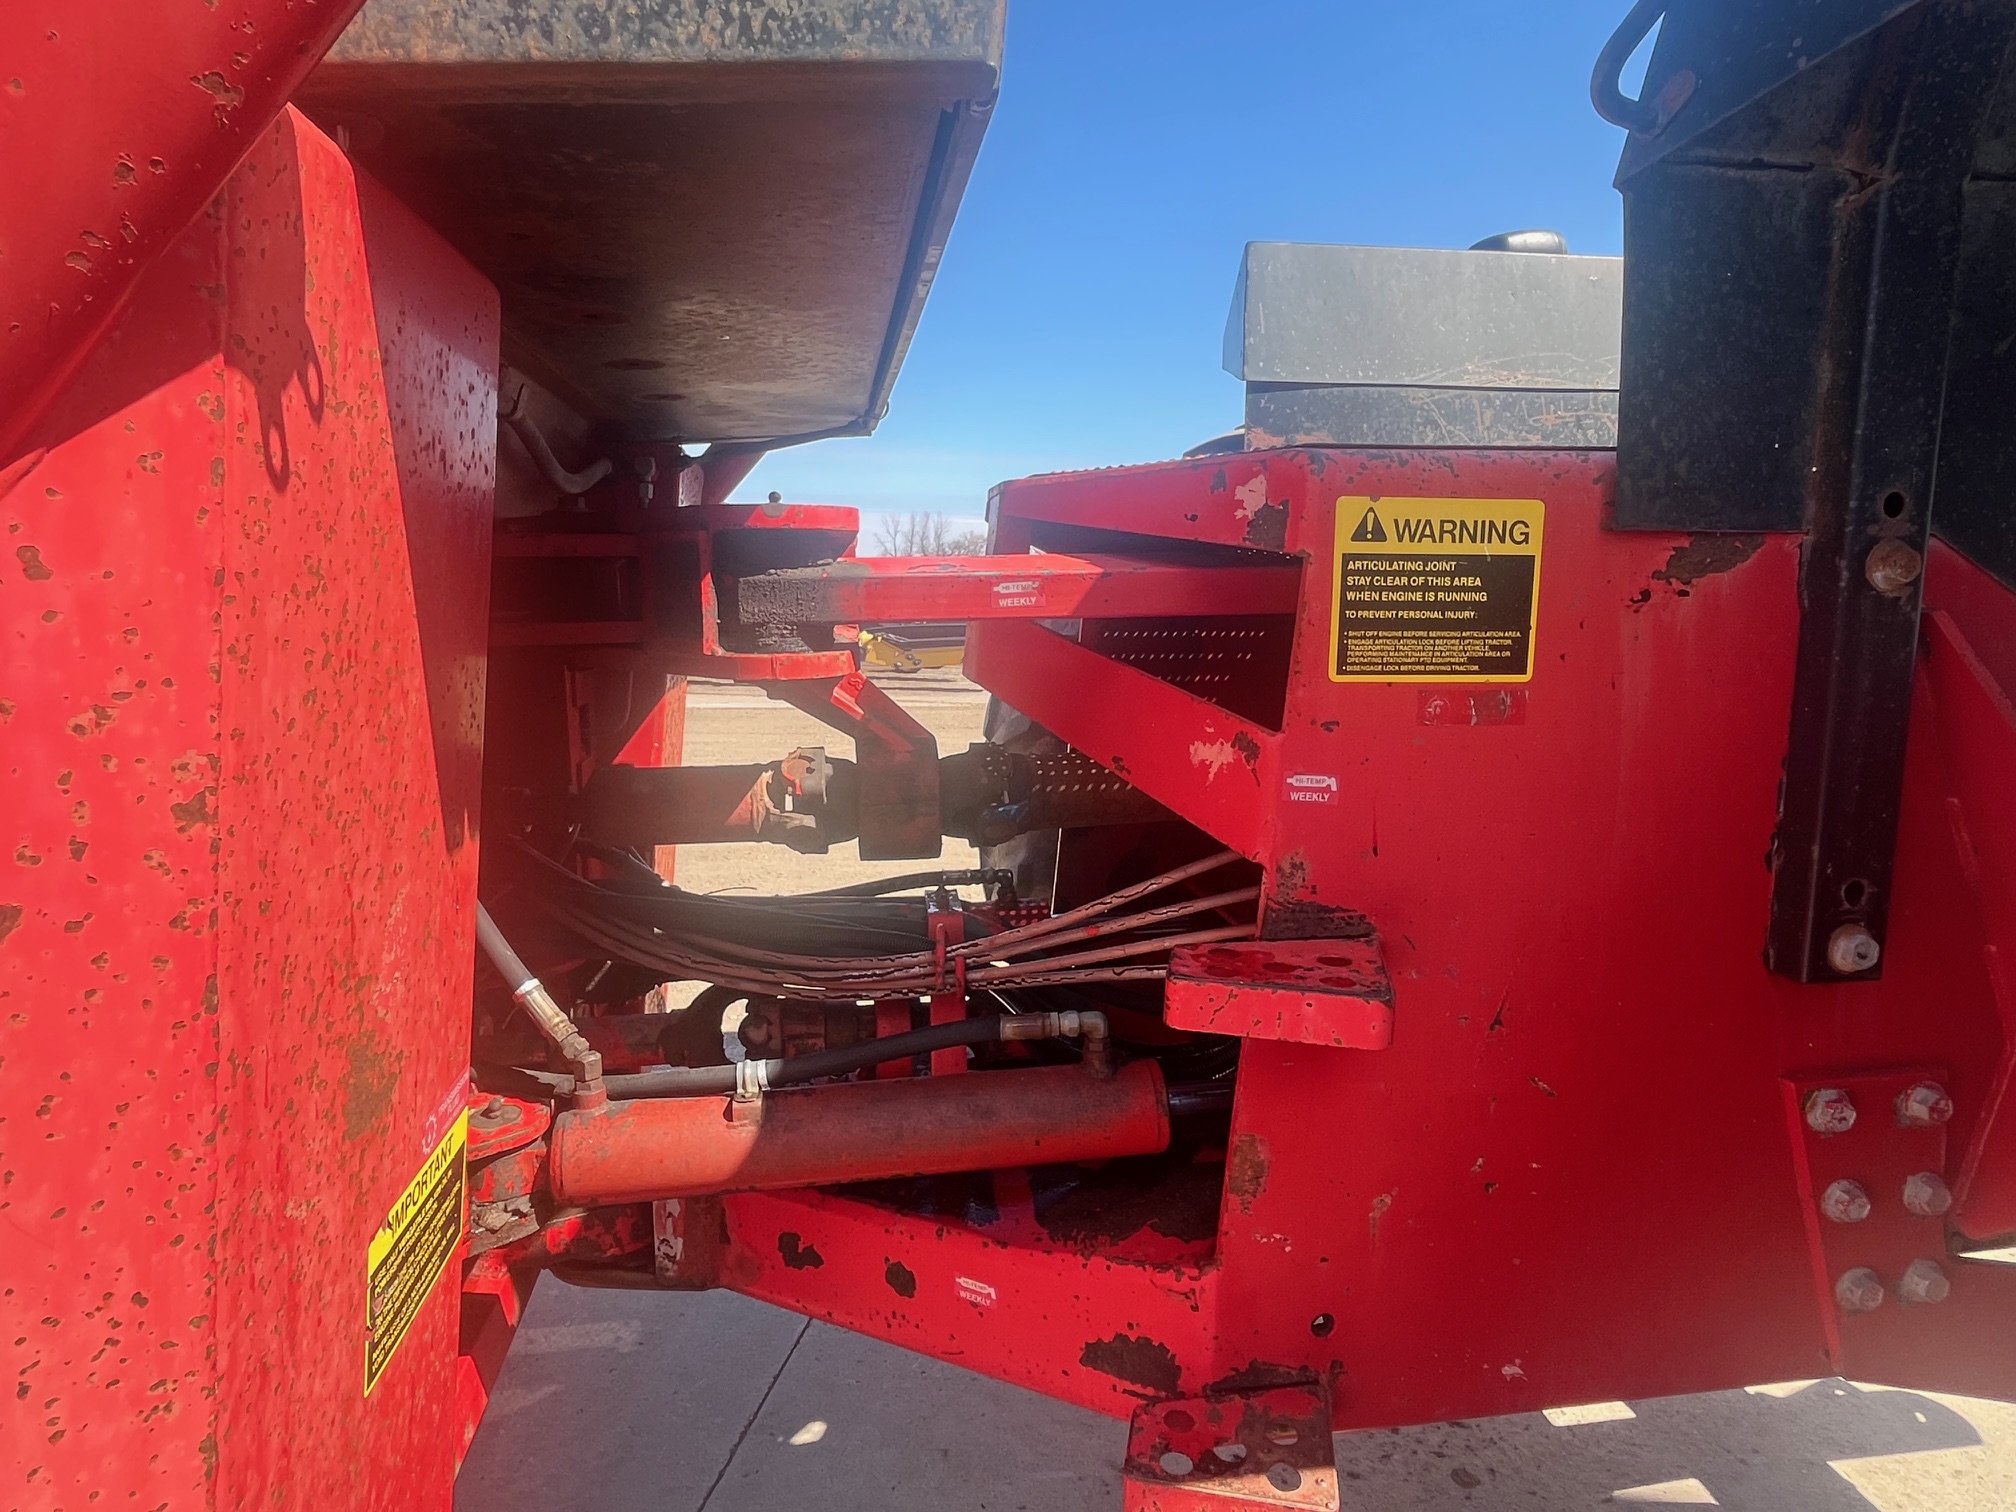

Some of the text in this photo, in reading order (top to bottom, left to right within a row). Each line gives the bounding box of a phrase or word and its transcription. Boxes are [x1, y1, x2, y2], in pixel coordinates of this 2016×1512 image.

[1394, 518, 1530, 545] WARNING
[1347, 561, 1456, 571] ARTICULATING JOINT
[1346, 576, 1482, 586] STAY CLEAR OF THIS AREA
[998, 596, 1036, 607] WEEKLY
[1346, 592, 1487, 601] WHEN ENGINE IS RUNNING
[1345, 611, 1478, 619] TO PREVENT PERSONAL INJURY:
[1290, 792, 1330, 802] WEEKLY
[391, 1132, 454, 1239] IMPORTANT
[960, 1290, 991, 1306] WEEKLY
